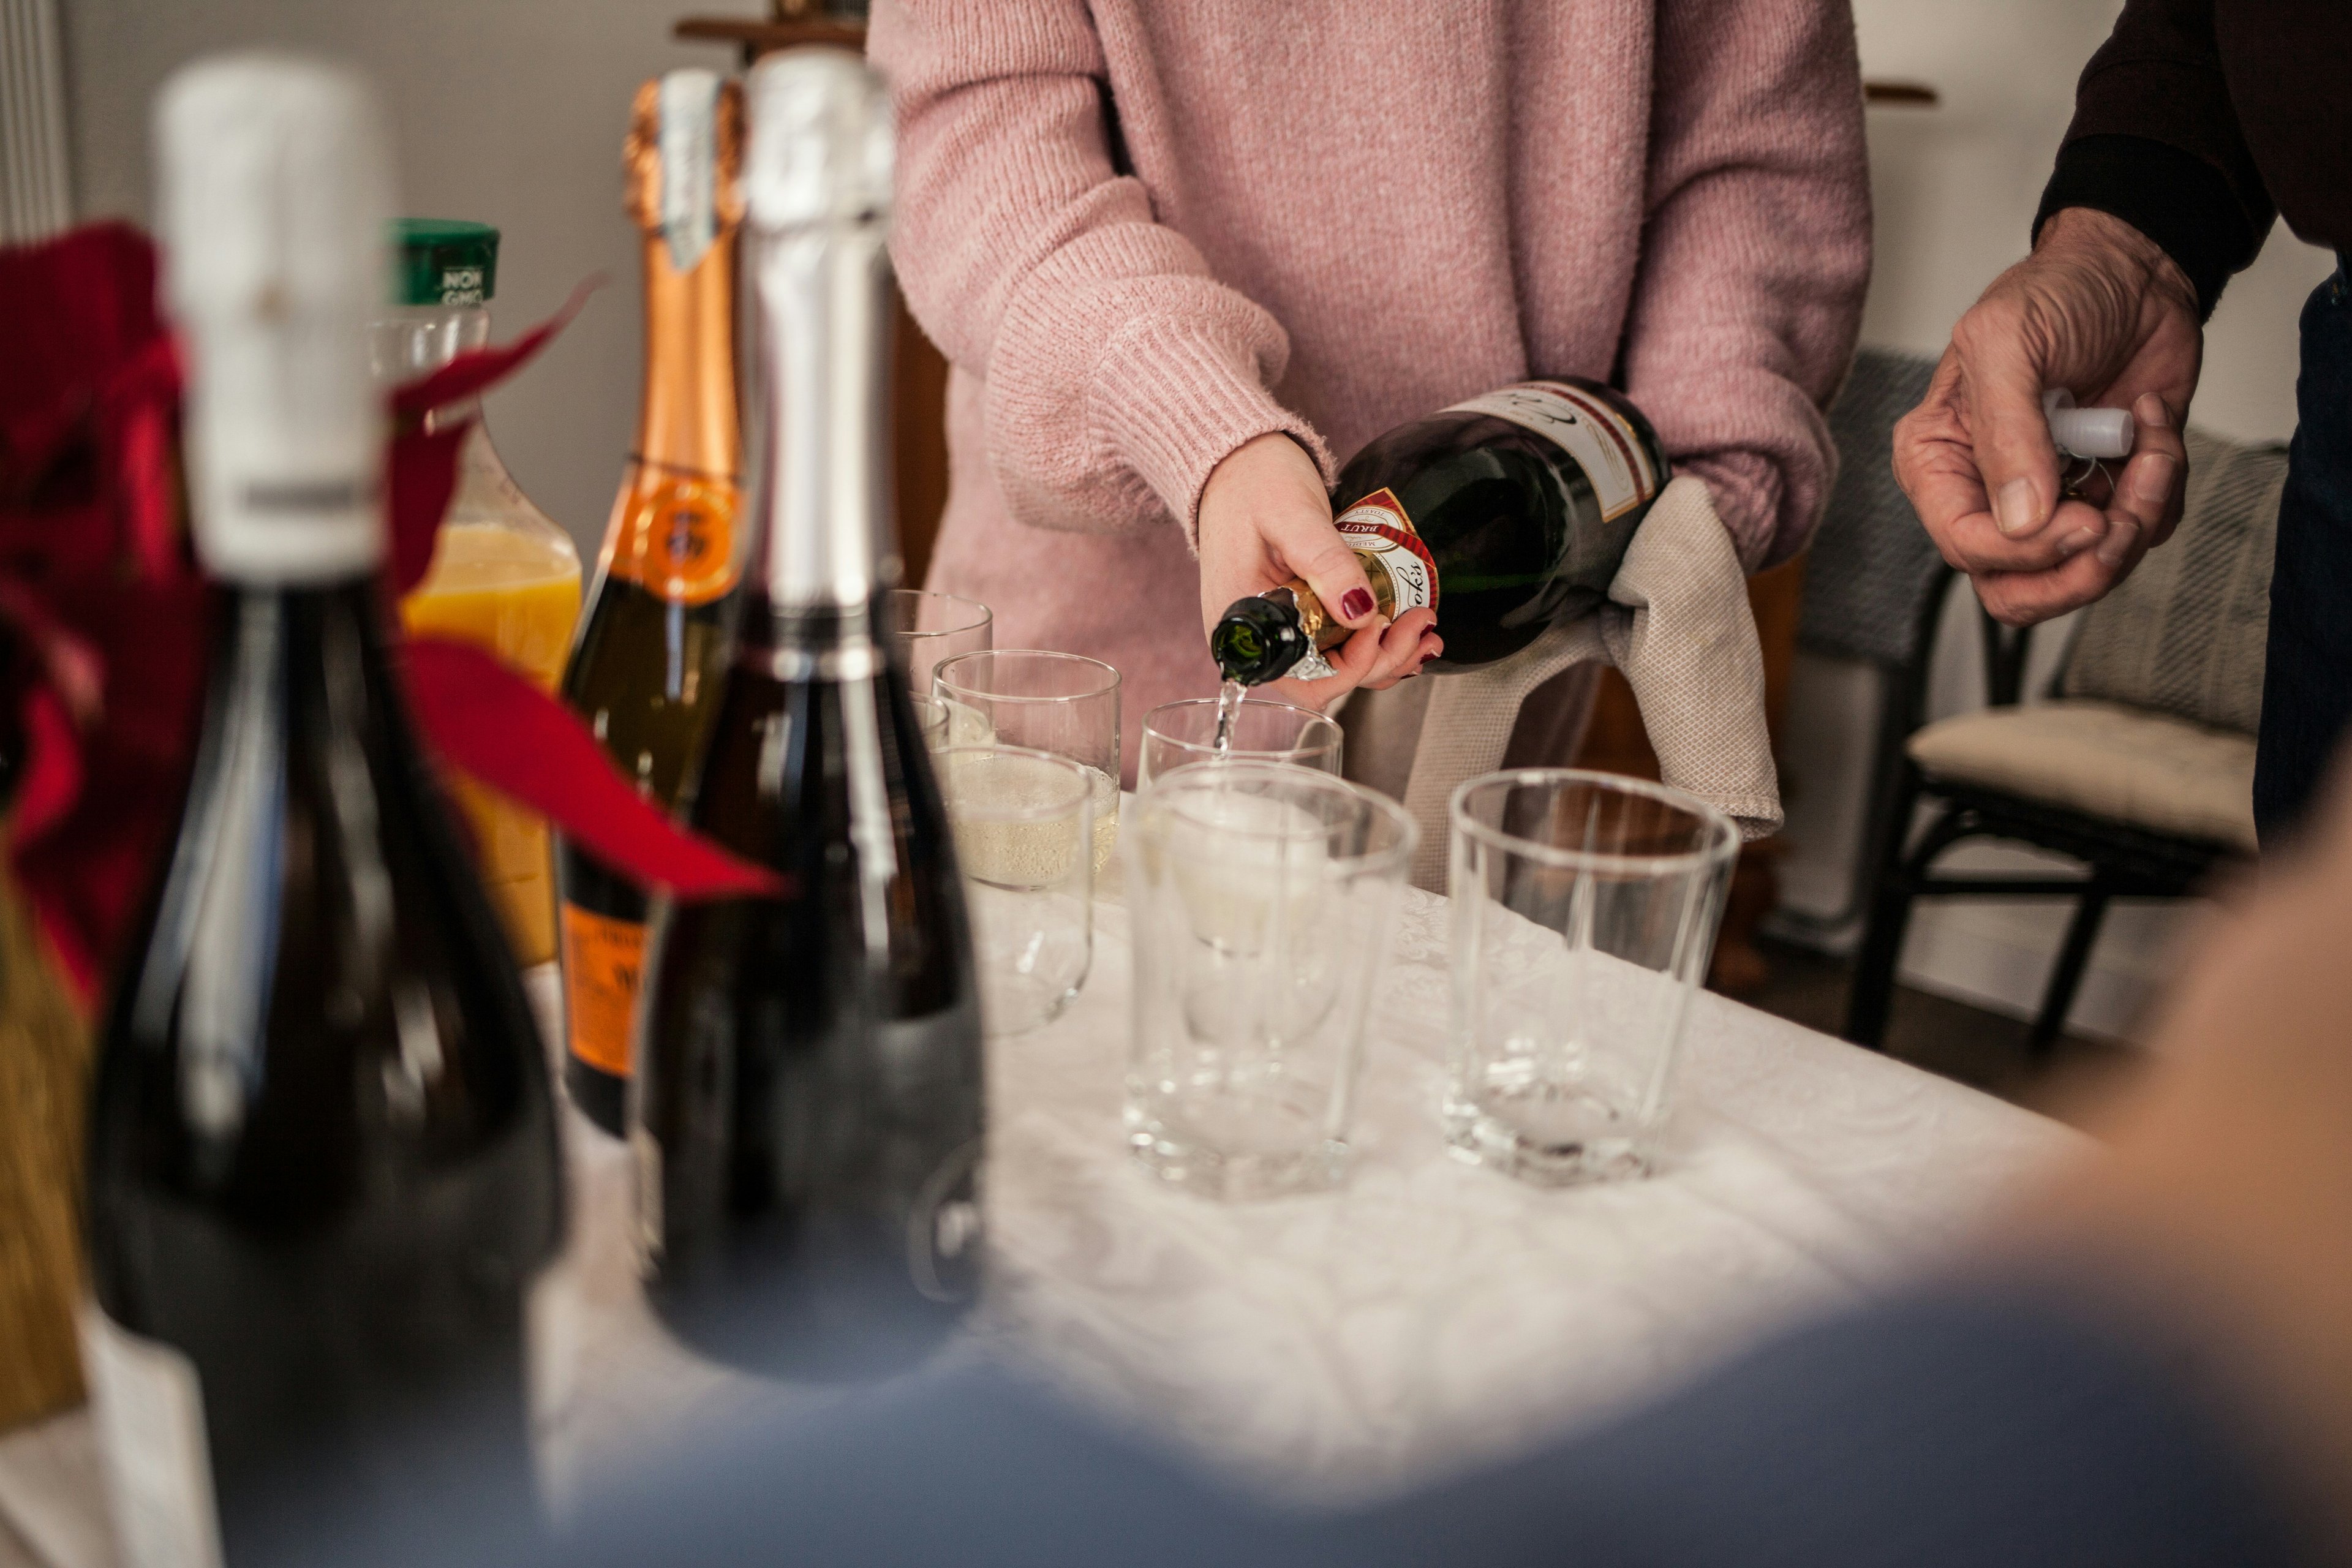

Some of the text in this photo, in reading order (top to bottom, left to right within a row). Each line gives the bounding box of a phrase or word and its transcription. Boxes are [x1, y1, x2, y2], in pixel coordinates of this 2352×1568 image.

[443, 271, 483, 289] NON
[1341, 524, 1379, 532] BRUT
[1396, 561, 1423, 608] ok's
